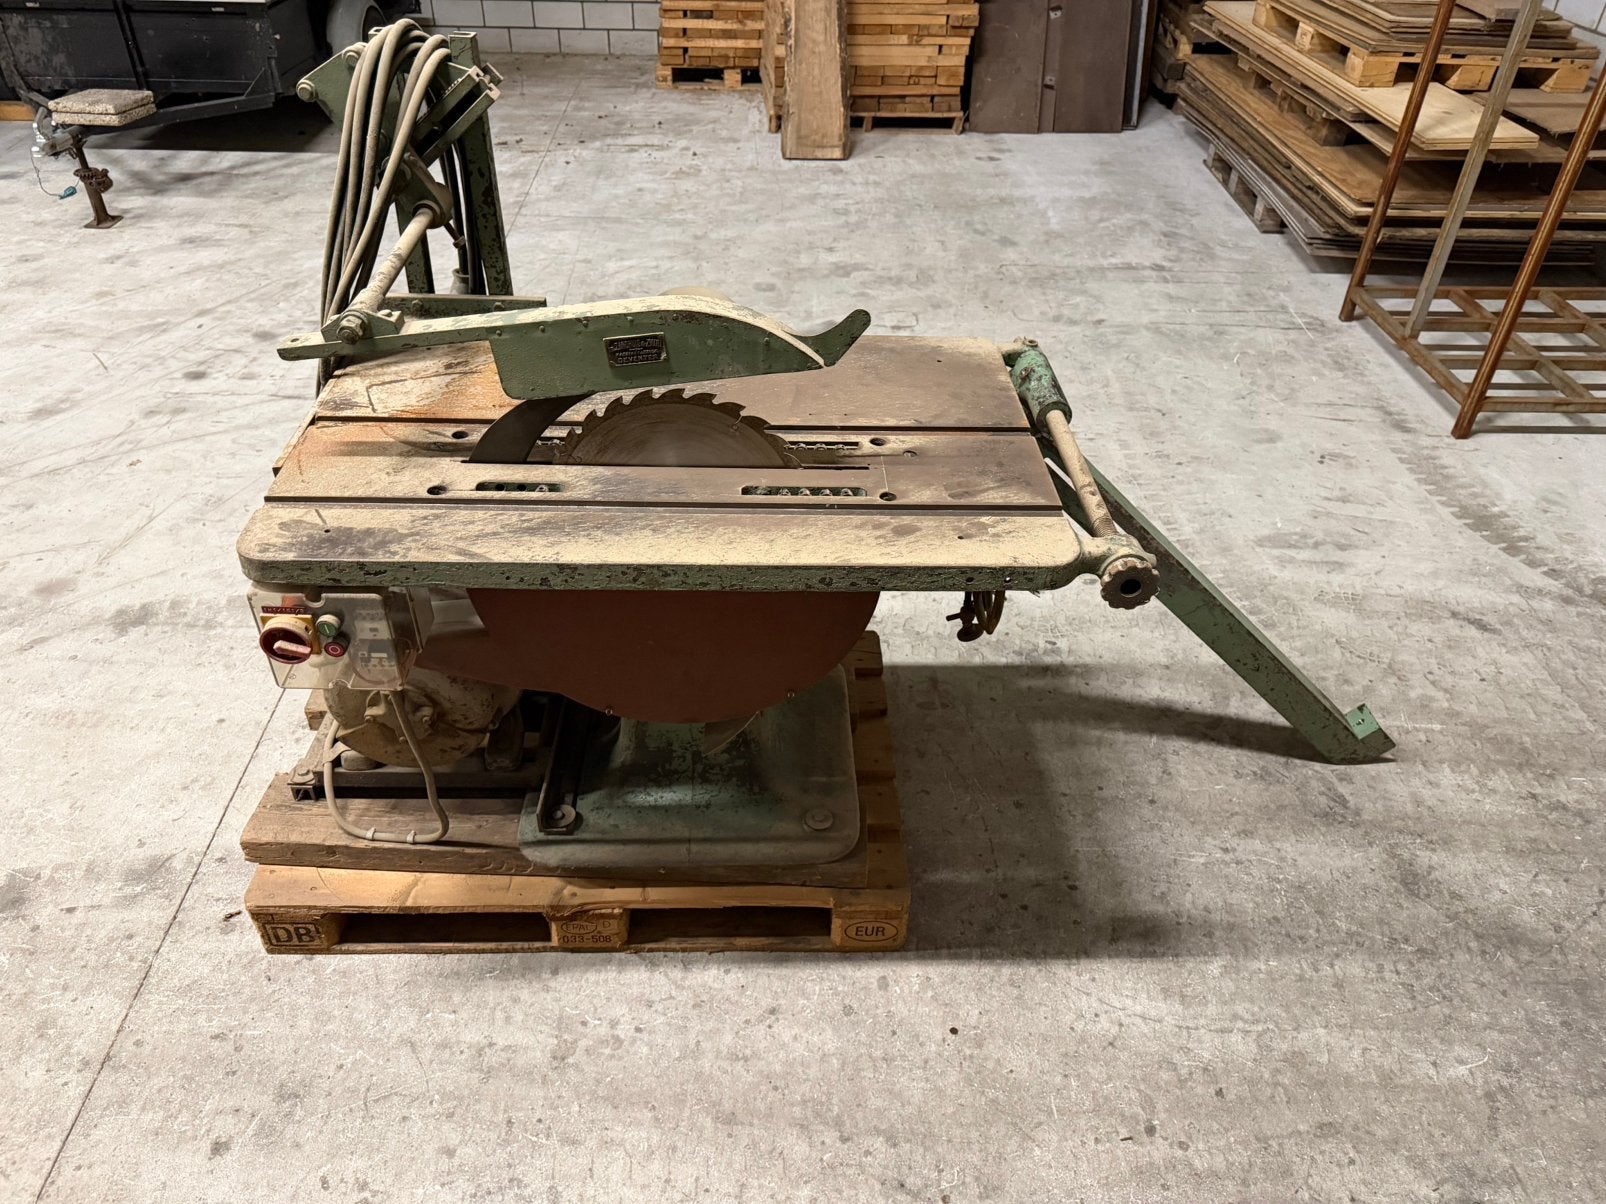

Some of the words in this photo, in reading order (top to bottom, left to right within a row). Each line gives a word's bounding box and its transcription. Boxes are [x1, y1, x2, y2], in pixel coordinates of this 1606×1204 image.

[270, 926, 316, 943] DB
[855, 925, 886, 937] EUR
[562, 934, 612, 944] 033-508
